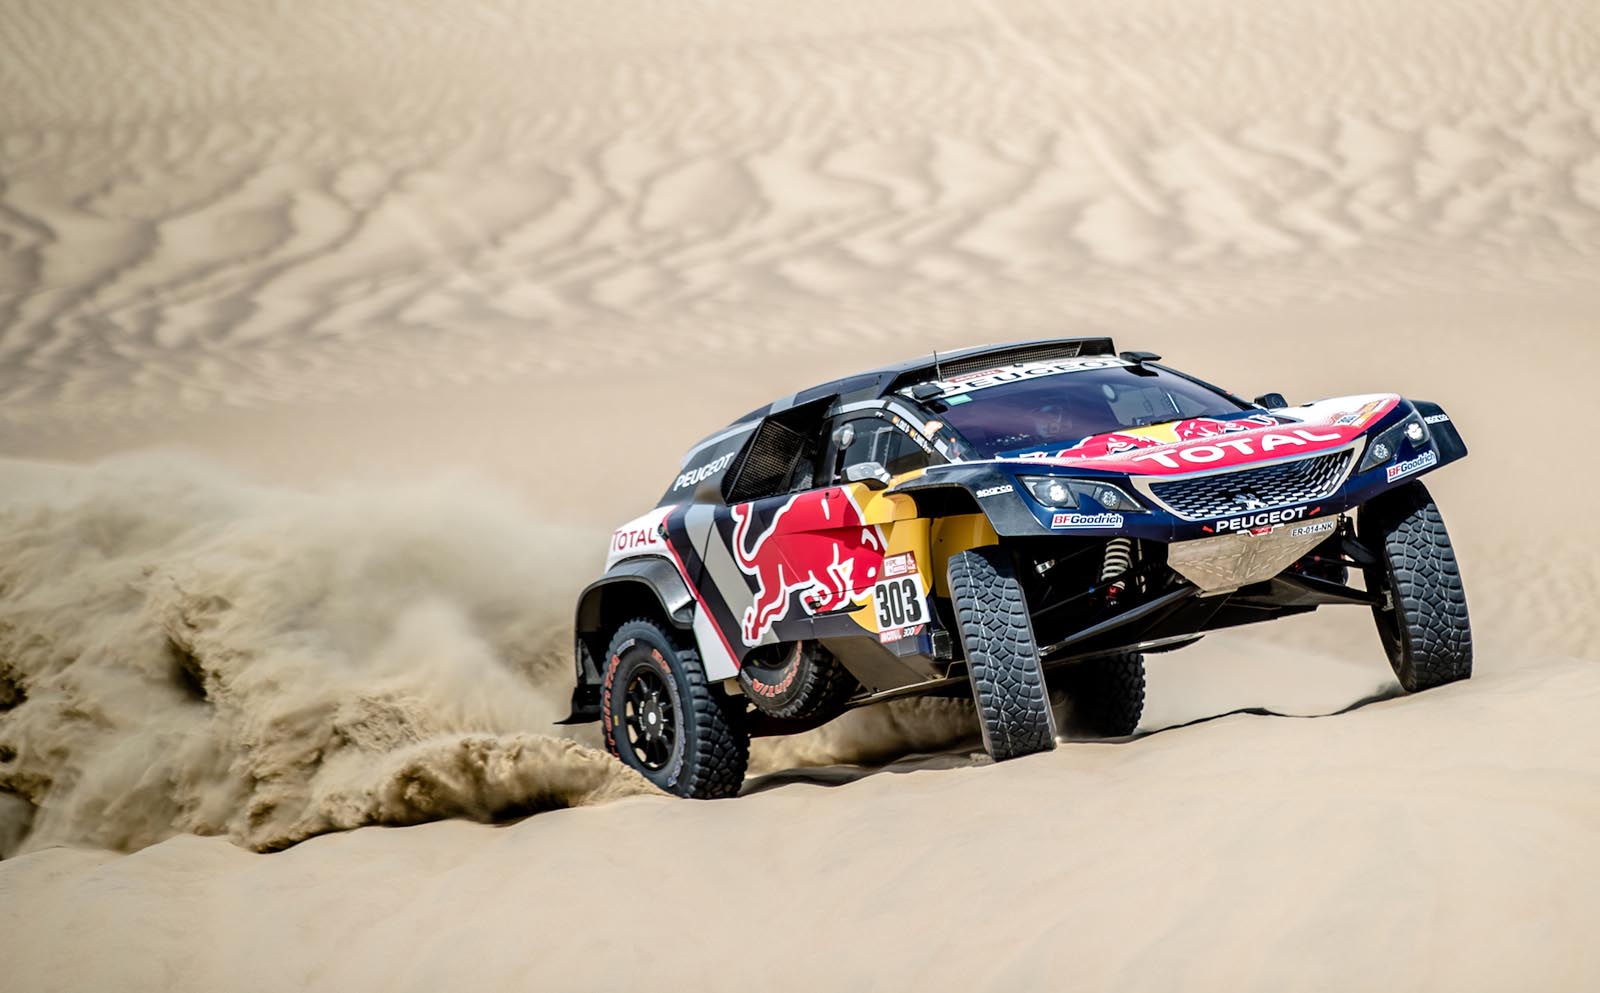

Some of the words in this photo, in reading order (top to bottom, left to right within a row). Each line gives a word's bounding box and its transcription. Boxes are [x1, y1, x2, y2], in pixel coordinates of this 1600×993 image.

[1132, 429, 1343, 468] TOTAL
[673, 452, 735, 491] PEUGEOT
[1388, 452, 1435, 477] BFGoodrich
[976, 485, 1014, 498] sparco
[1054, 513, 1122, 524] BFGoodrich
[1216, 506, 1307, 533] PEUGEOT
[1292, 522, 1333, 537] ER-014-NK
[613, 528, 657, 551] TOTAL
[875, 578, 922, 628] 303
